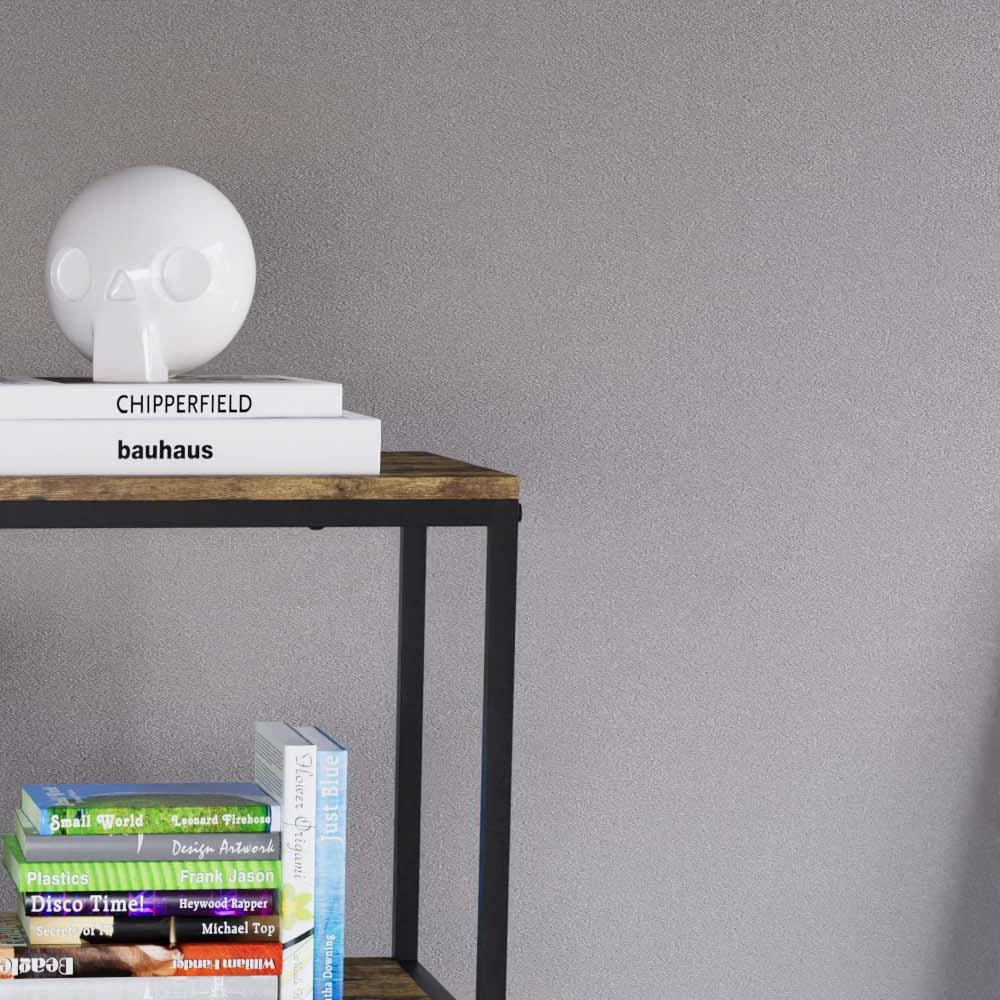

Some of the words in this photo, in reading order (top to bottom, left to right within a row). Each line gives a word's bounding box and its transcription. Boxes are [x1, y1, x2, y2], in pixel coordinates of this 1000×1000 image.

[116, 394, 252, 414] CHIPPERFIELD
[118, 439, 214, 460] bauhaus
[321, 754, 340, 797] Blue
[50, 814, 91, 832] Small
[96, 813, 144, 830] World
[321, 804, 344, 841] Just
[171, 839, 215, 860] Design
[219, 838, 275, 855] Artwork
[27, 871, 89, 886] Plastics
[180, 869, 223, 884] Frank
[229, 869, 275, 884] Jason
[31, 895, 84, 913] Disco
[90, 894, 145, 913] Time!
[179, 897, 228, 911] Heywood
[231, 898, 269, 911] Rapper
[202, 921, 249, 935] Michael
[252, 922, 275, 936] Top
[322, 934, 336, 979] Downing
[0, 957, 74, 976] Beagle
